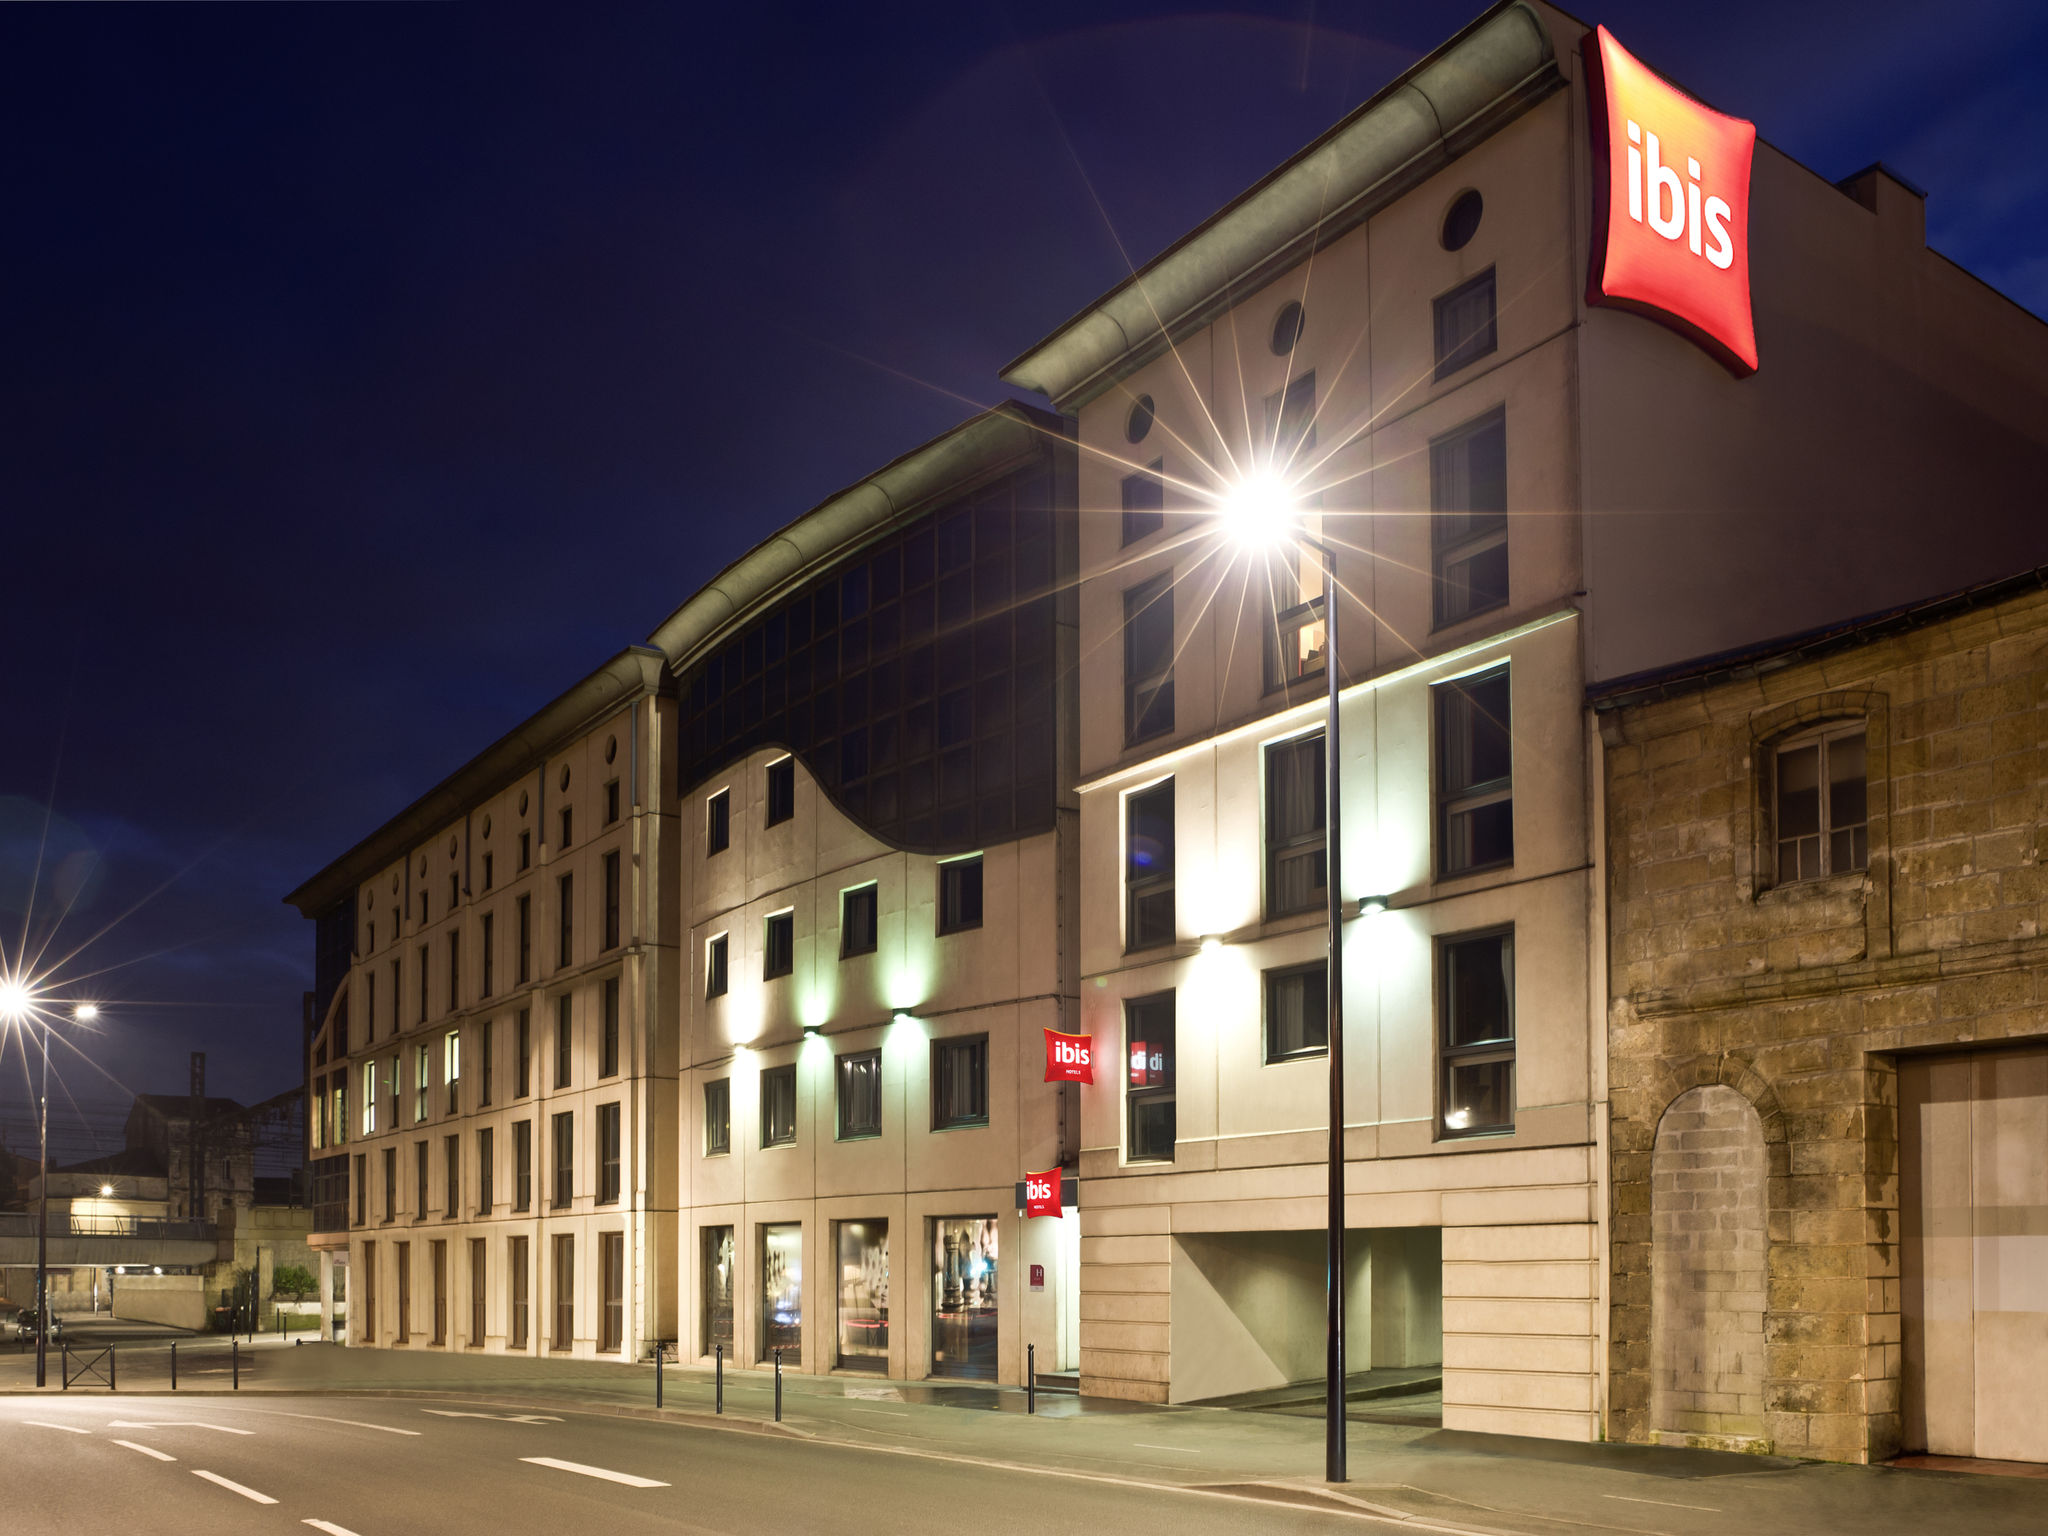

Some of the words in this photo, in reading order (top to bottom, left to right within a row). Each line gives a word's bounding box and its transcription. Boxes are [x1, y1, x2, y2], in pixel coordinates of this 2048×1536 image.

[1627, 119, 1733, 269] ibis
[1055, 1041, 1090, 1065] ibis
[1026, 1179, 1052, 1200] ibis
